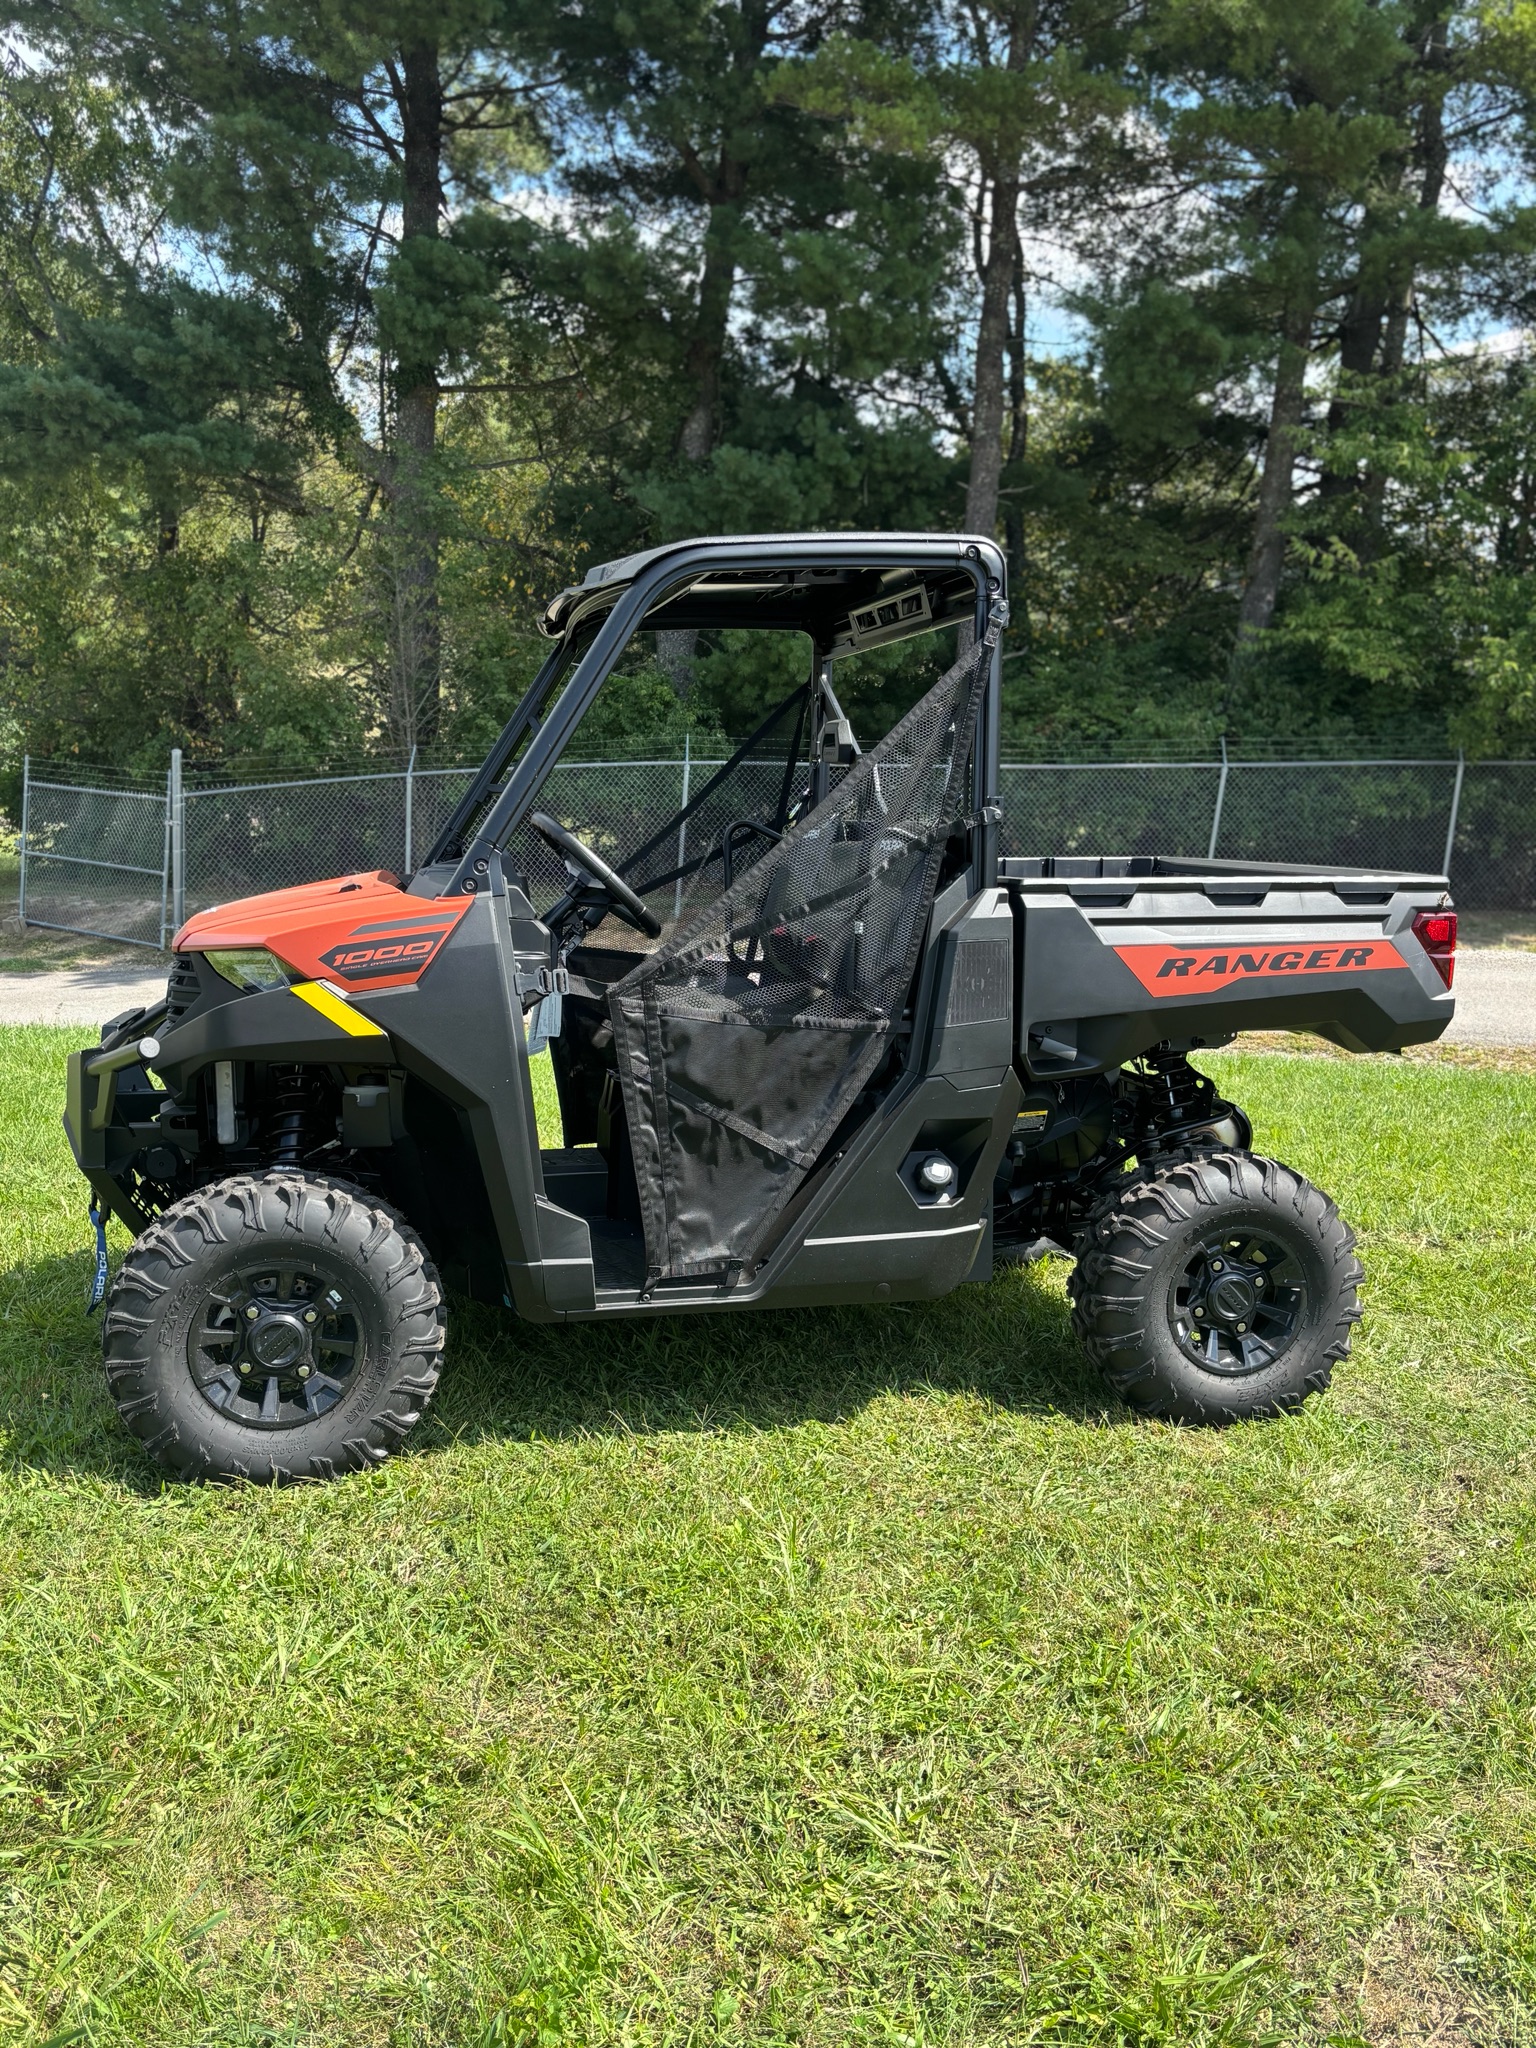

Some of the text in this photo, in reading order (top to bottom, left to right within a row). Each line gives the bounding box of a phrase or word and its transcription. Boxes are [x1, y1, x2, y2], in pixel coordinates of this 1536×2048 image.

[333, 941, 434, 966] 1000
[340, 963, 368, 971] SINGLE
[370, 957, 411, 967] OVERHEAD
[1155, 947, 1374, 977] RANGER
[93, 1251, 107, 1305] POLARIS
